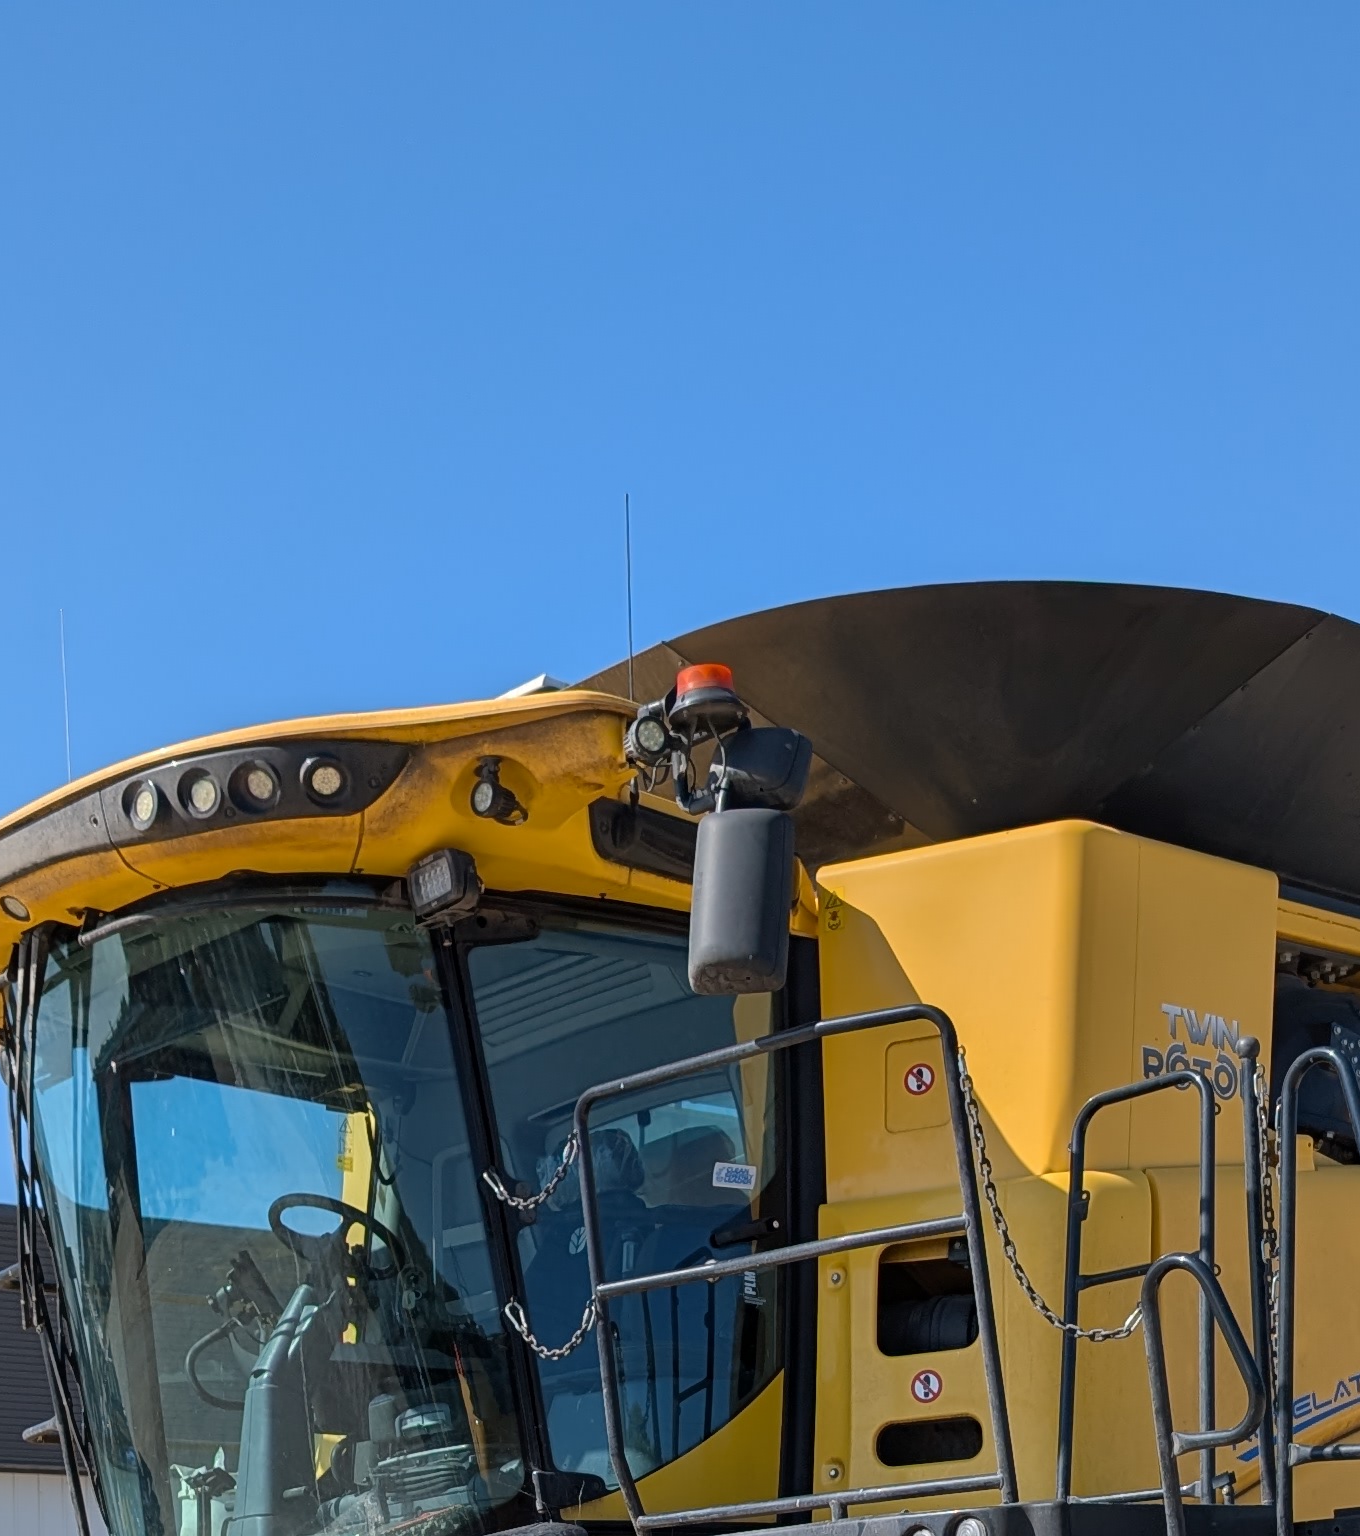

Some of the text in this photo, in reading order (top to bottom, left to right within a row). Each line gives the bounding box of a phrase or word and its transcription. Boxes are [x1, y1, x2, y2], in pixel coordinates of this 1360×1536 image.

[1161, 1003, 1240, 1054] TWIN
[1142, 1042, 1246, 1101] ROTO
[744, 1271, 757, 1296] PLM
